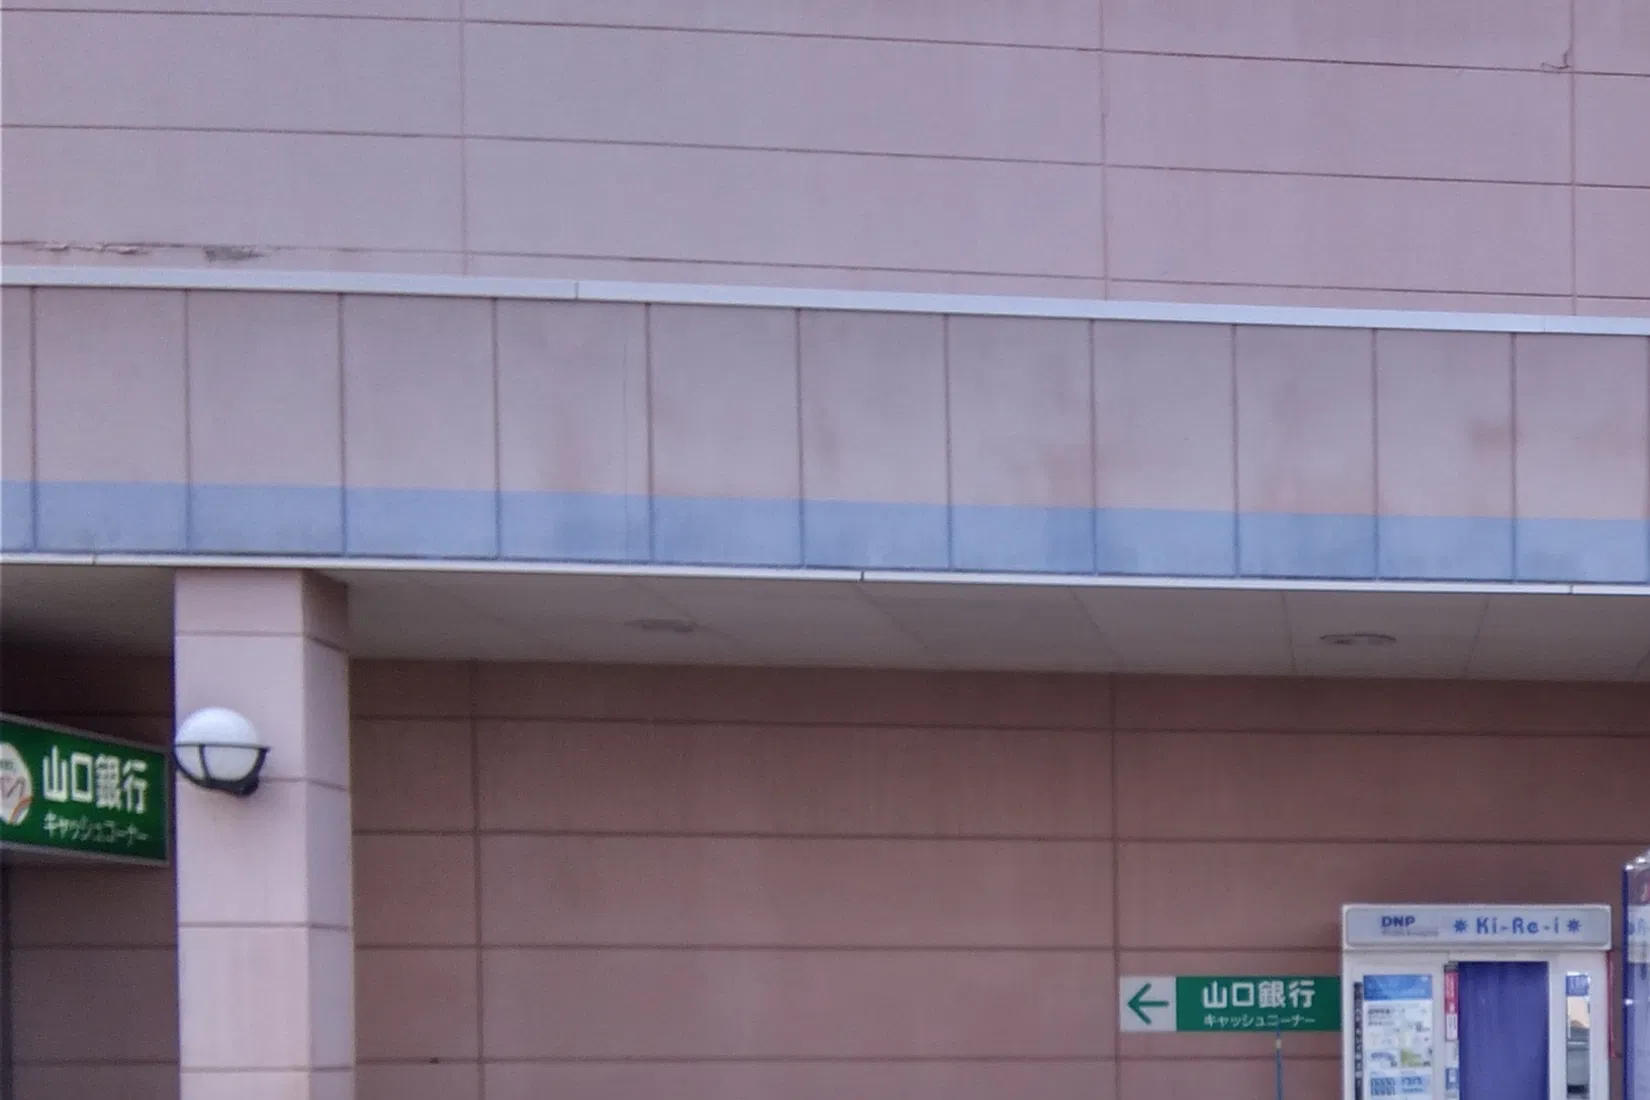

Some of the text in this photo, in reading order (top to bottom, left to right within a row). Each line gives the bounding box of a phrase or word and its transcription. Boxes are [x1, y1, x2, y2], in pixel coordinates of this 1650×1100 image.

[43, 745, 148, 815] 山口銀行
[1381, 915, 1416, 928] DNP
[1203, 980, 1316, 1009] 山口銀行
